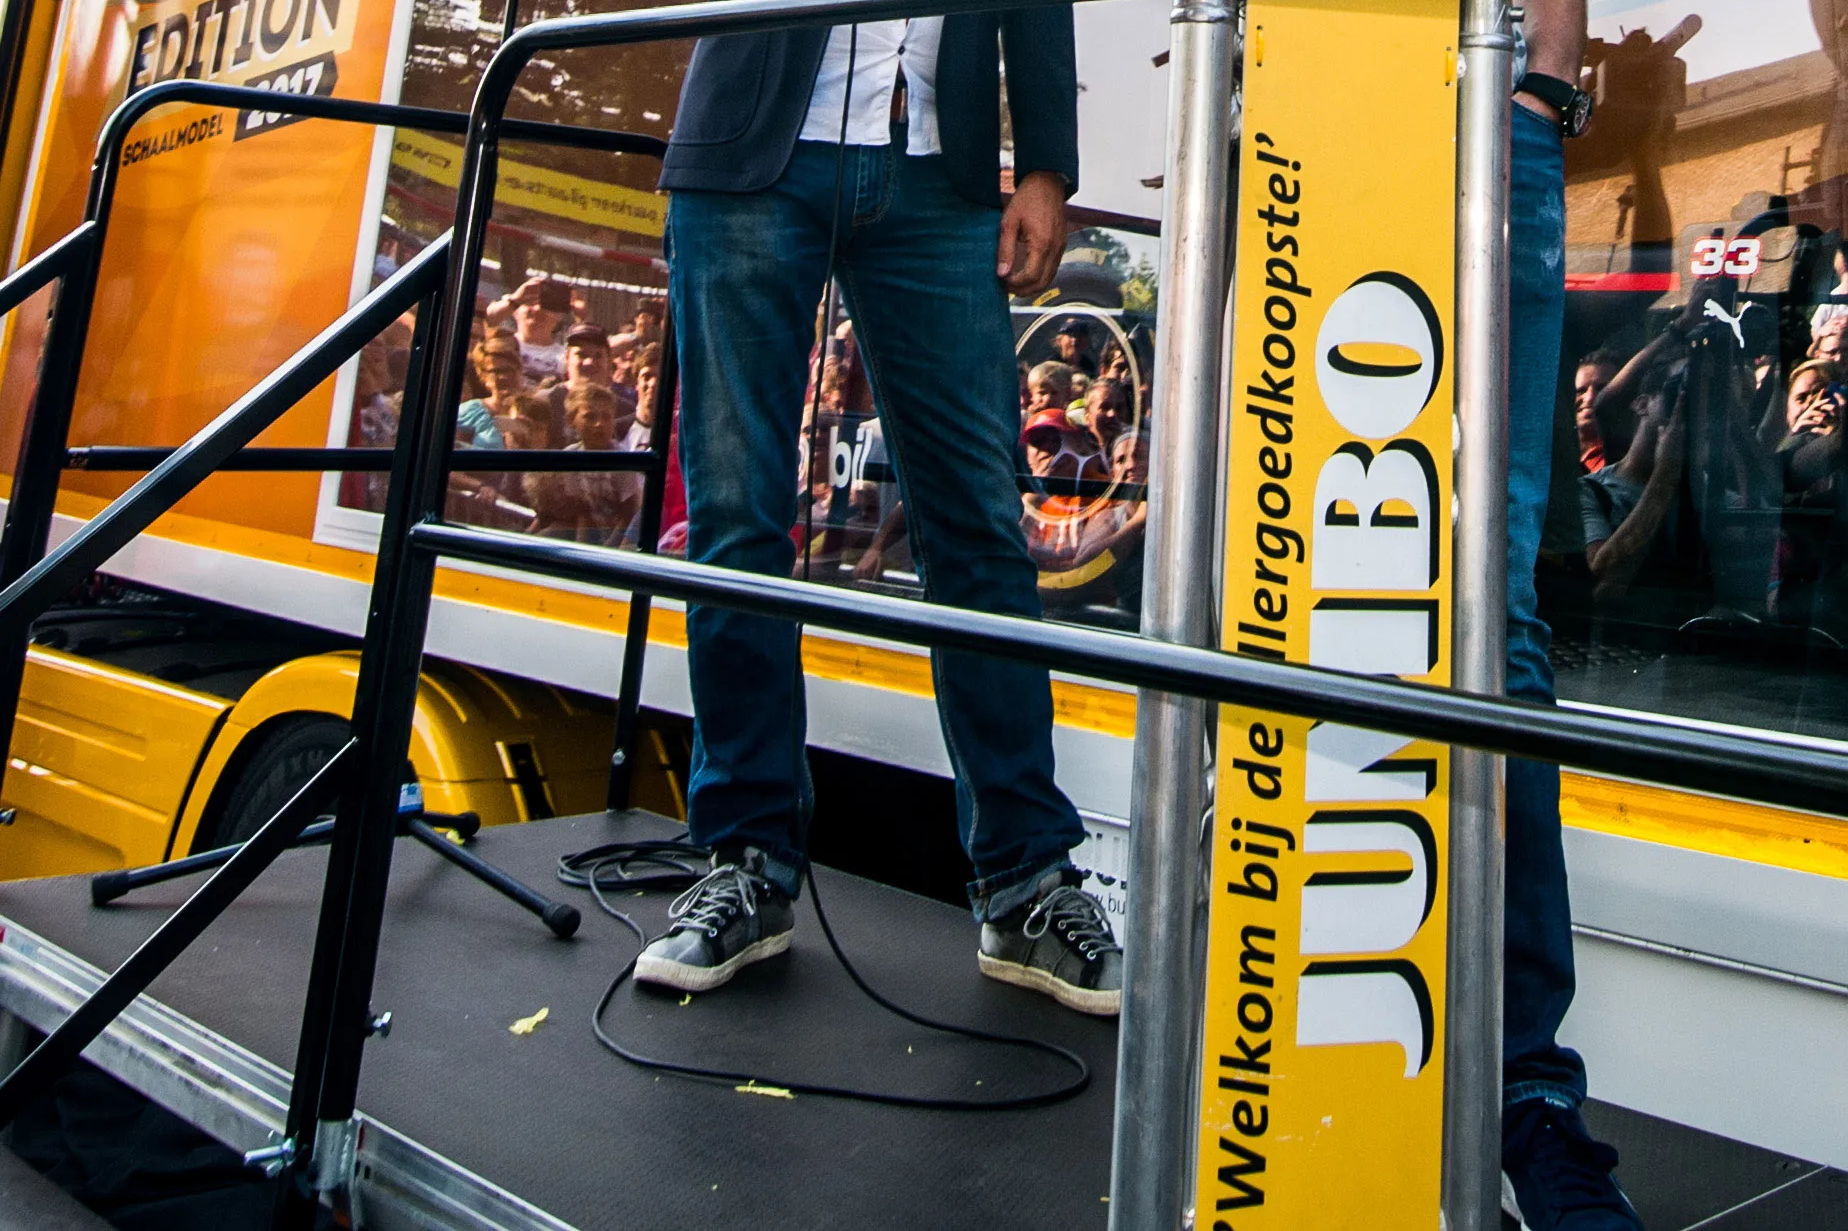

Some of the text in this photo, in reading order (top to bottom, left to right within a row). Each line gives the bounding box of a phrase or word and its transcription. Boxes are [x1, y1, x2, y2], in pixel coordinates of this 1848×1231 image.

[122, 113, 225, 167] SCHAALMODEL
[1689, 236, 1763, 278] 33
[1296, 270, 1444, 1079] JUMBO
[1232, 721, 1284, 799] de
[1227, 817, 1296, 902] bij
